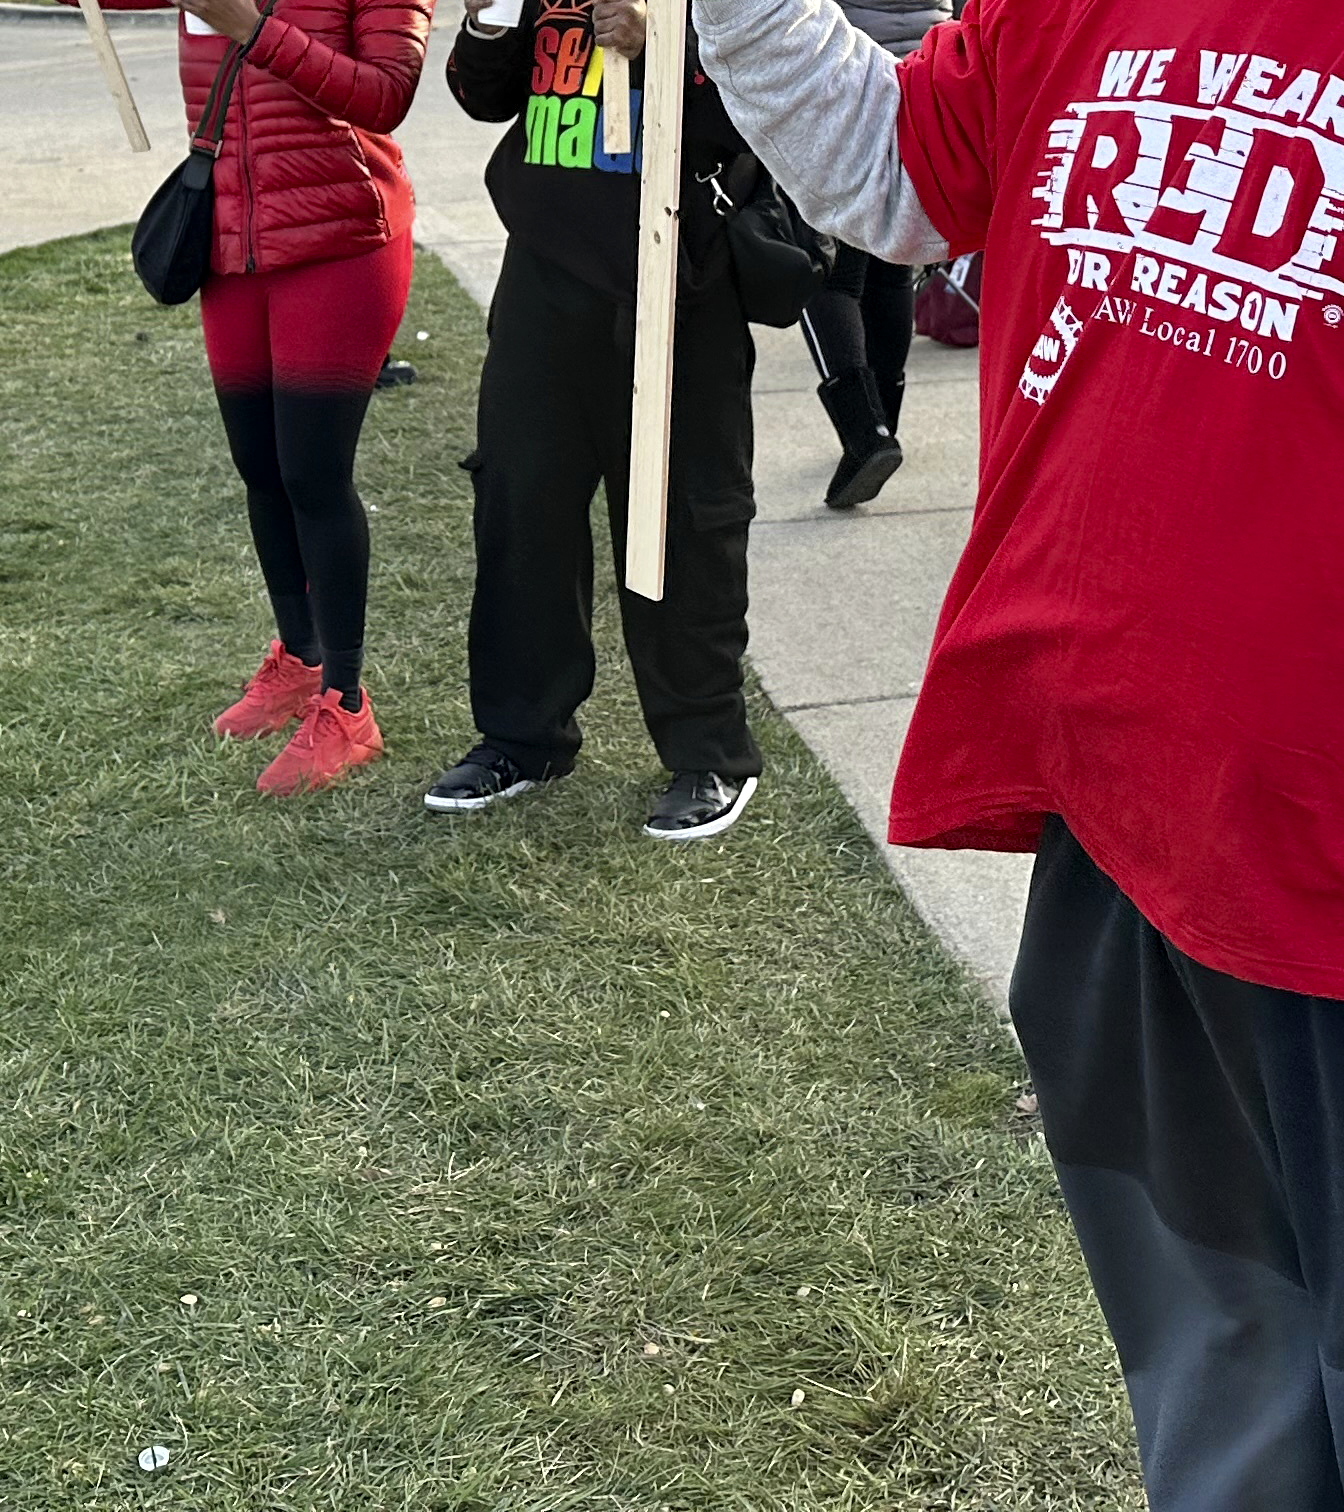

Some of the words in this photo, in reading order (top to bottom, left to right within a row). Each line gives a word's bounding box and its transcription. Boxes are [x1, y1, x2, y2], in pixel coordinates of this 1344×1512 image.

[1096, 47, 1177, 98] WE
[1060, 110, 1326, 273] RED
[1093, 295, 1138, 328] AW
[1138, 305, 1217, 357] Local
[1223, 335, 1288, 381] 1700
[1129, 253, 1301, 342] REASON
[1031, 333, 1061, 363] AW
